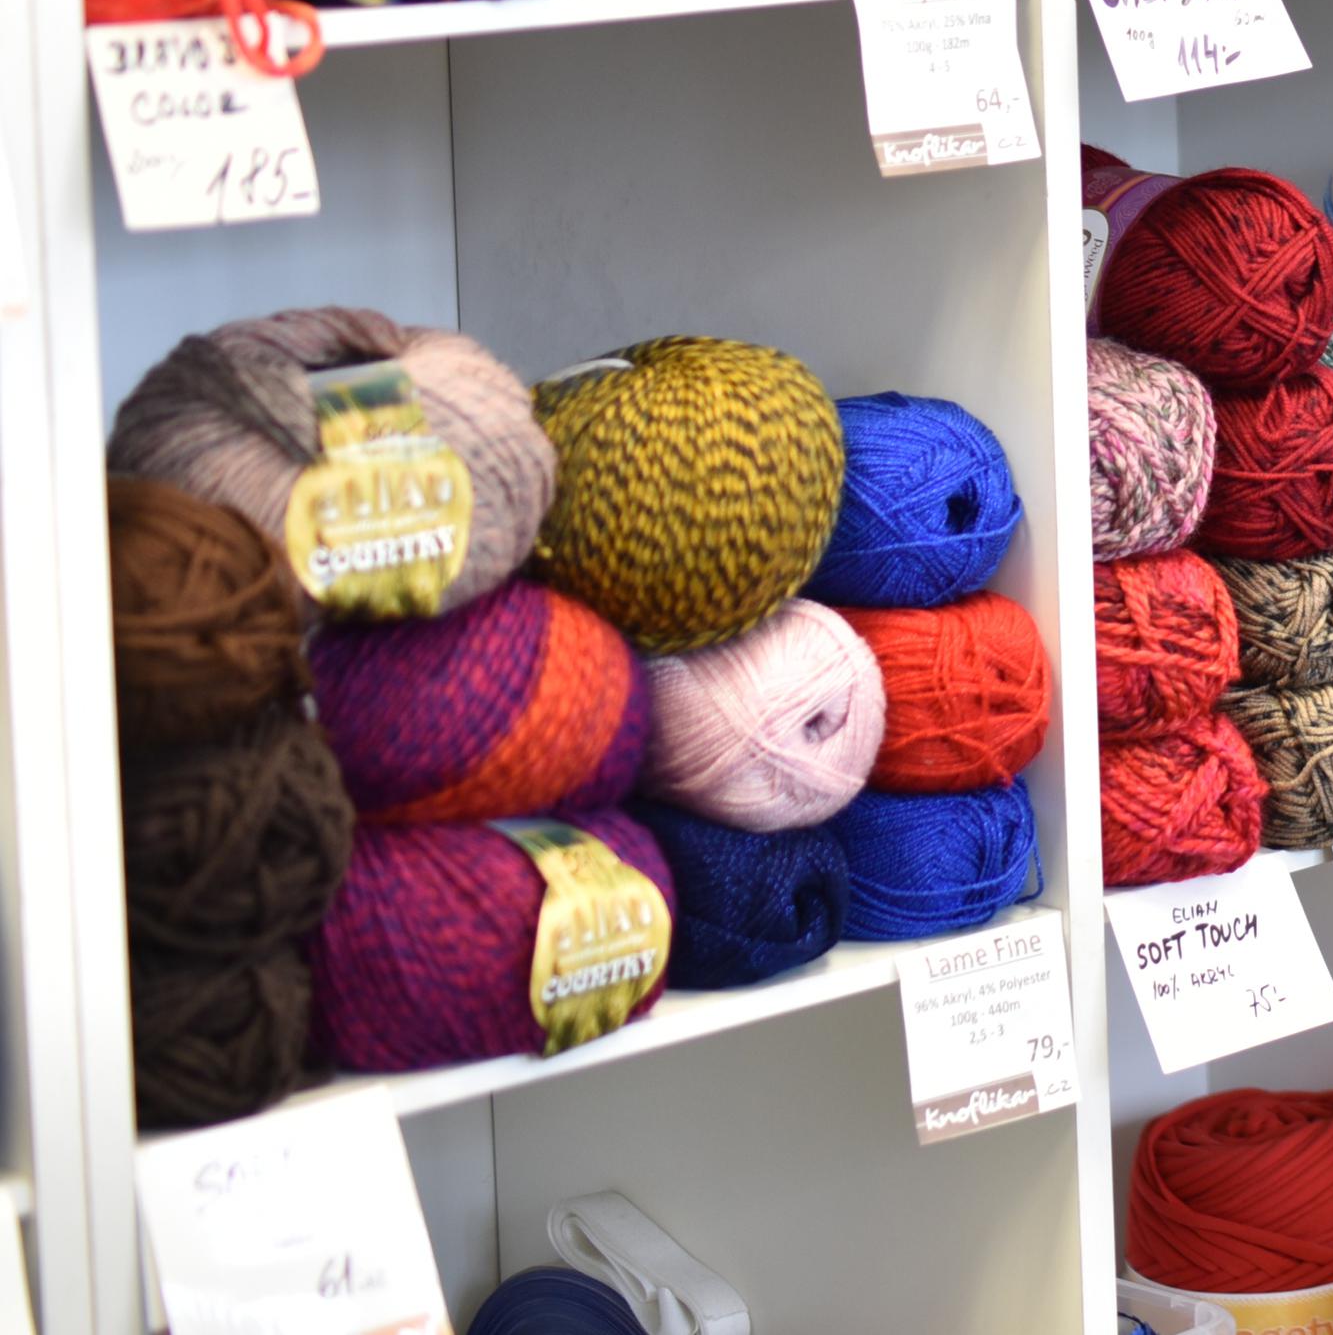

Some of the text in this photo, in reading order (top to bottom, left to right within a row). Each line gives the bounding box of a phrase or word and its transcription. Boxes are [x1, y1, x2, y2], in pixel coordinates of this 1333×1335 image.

[967, 12, 992, 26] Vlna
[1172, 900, 1218, 924] ELIAN
[1137, 913, 1258, 970] SOFT TOUCH
[925, 934, 1043, 979] Lame Fine
[914, 969, 1052, 1014] 96% Akryl, 4% Polyester
[951, 1010, 979, 1028] 100g
[988, 1000, 1021, 1016] 440m
[969, 1028, 988, 1046] 2,5
[998, 1024, 1006, 1037] 3
[1027, 1034, 1070, 1063] 79,-
